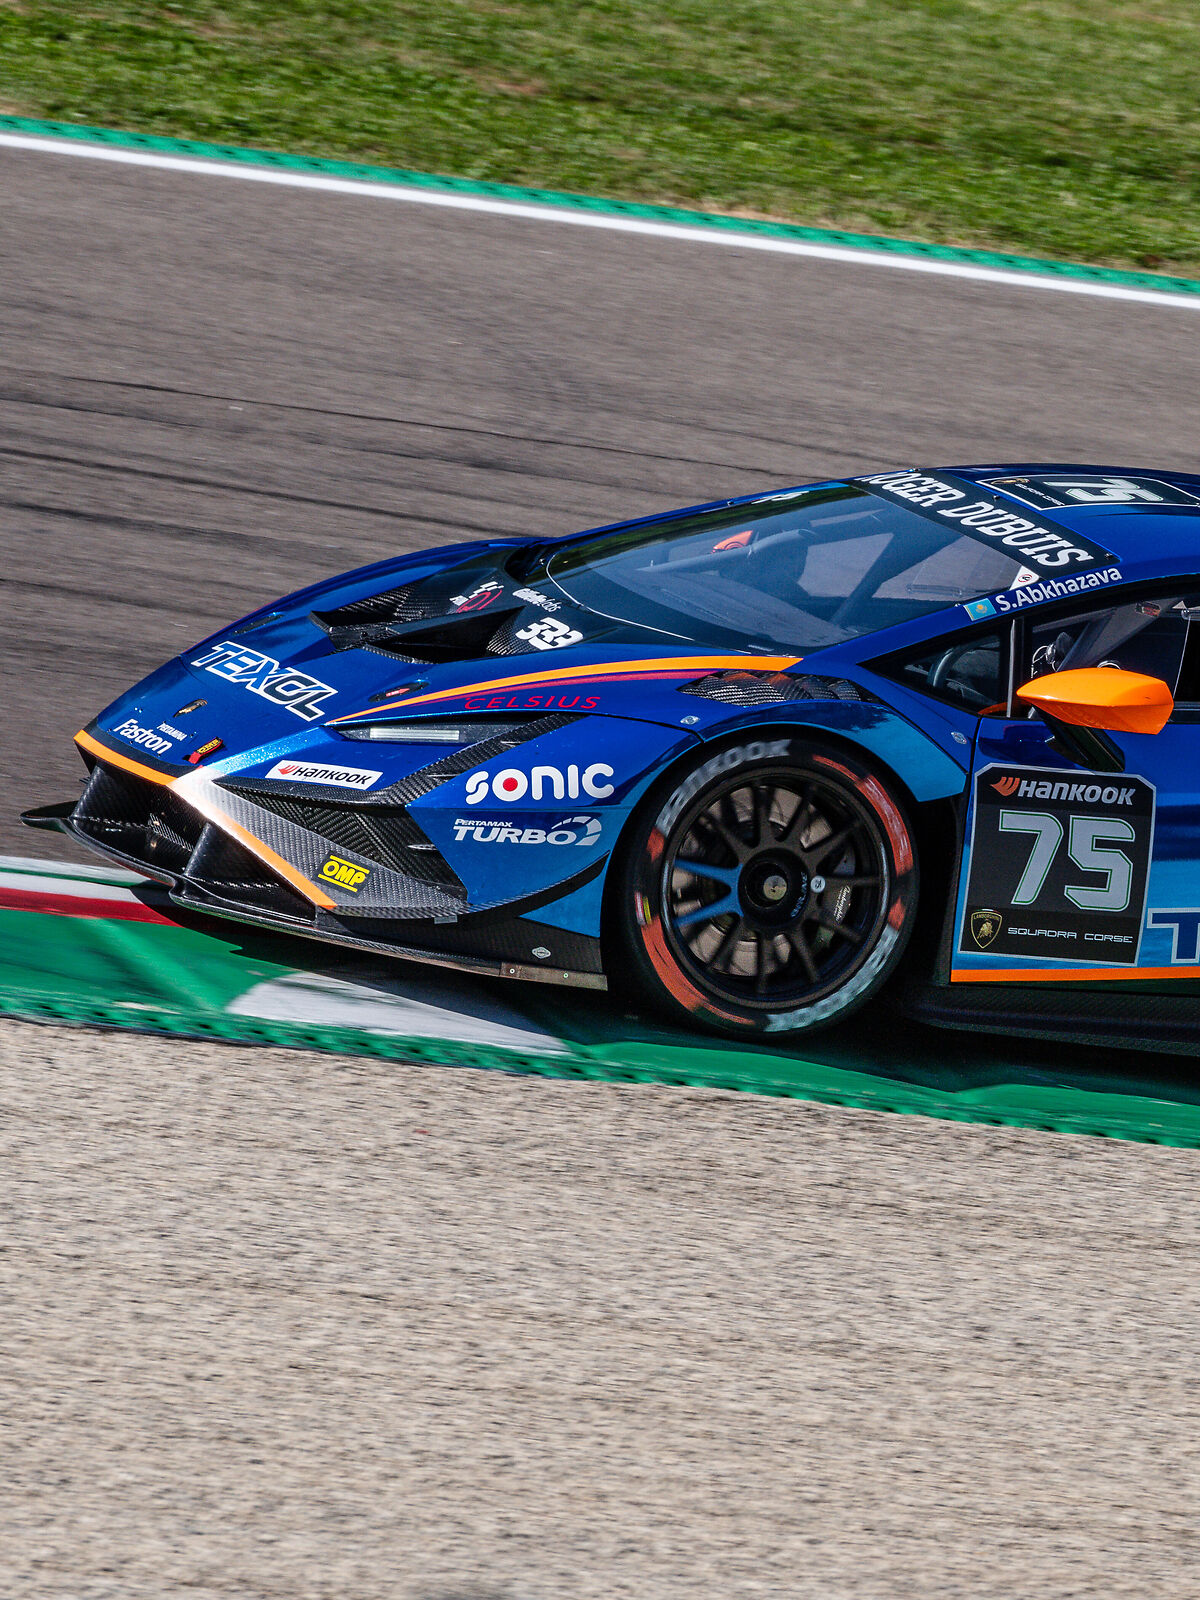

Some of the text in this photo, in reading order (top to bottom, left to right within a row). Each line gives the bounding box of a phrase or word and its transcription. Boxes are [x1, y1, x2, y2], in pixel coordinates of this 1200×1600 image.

[937, 501, 1093, 567] DUBUIS
[995, 566, 1122, 613] S.Abkhazava
[515, 617, 584, 651] 333
[463, 696, 601, 711] CELSIUS
[113, 718, 173, 755] Fastron
[454, 818, 513, 829] PERTAMAX
[321, 861, 367, 886] OMP
[998, 809, 1136, 912] 75
[1007, 927, 1133, 943] SQUADRA CORSE
